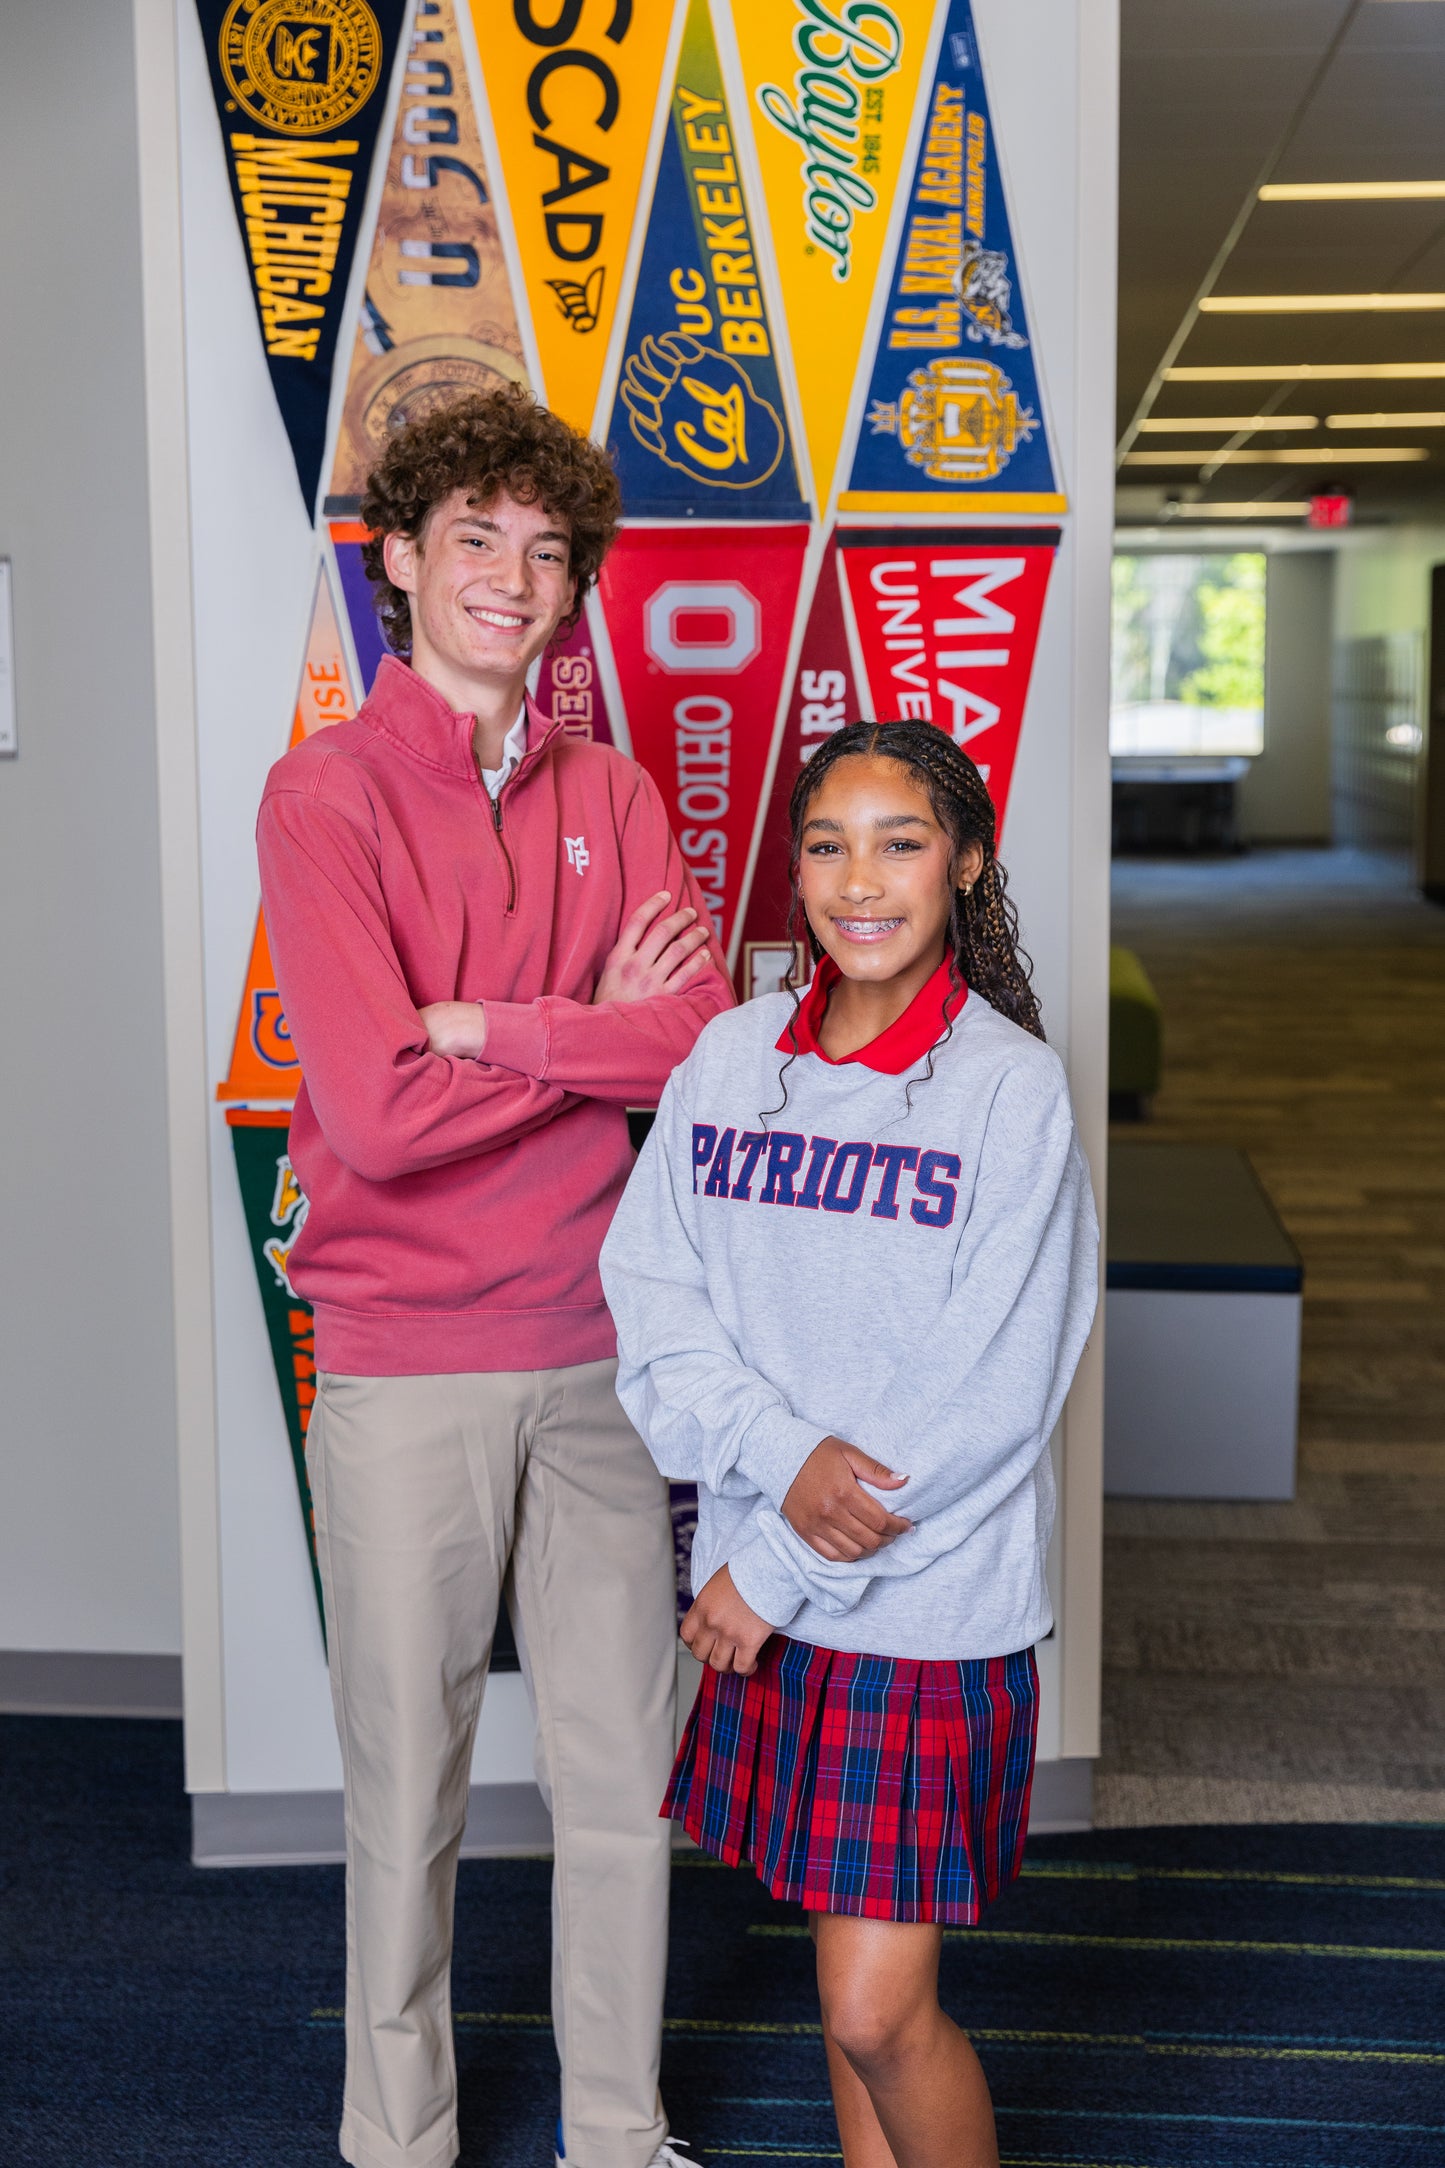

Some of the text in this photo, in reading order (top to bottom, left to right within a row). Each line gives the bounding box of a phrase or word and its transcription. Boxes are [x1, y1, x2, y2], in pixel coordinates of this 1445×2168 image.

[513, 0, 633, 262] SCAD
[676, 85, 771, 357] BERKELEY
[758, 0, 903, 282] Baylor
[888, 82, 964, 350] U.S. NAVAL ACADEMY
[230, 132, 360, 362] MICHIGAN
[669, 267, 714, 336] UC
[674, 376, 749, 470] Cal
[643, 579, 763, 676] O
[930, 558, 1026, 783] MIA
[673, 695, 733, 822] OHIO
[692, 1122, 962, 1229] PATRIOTS
